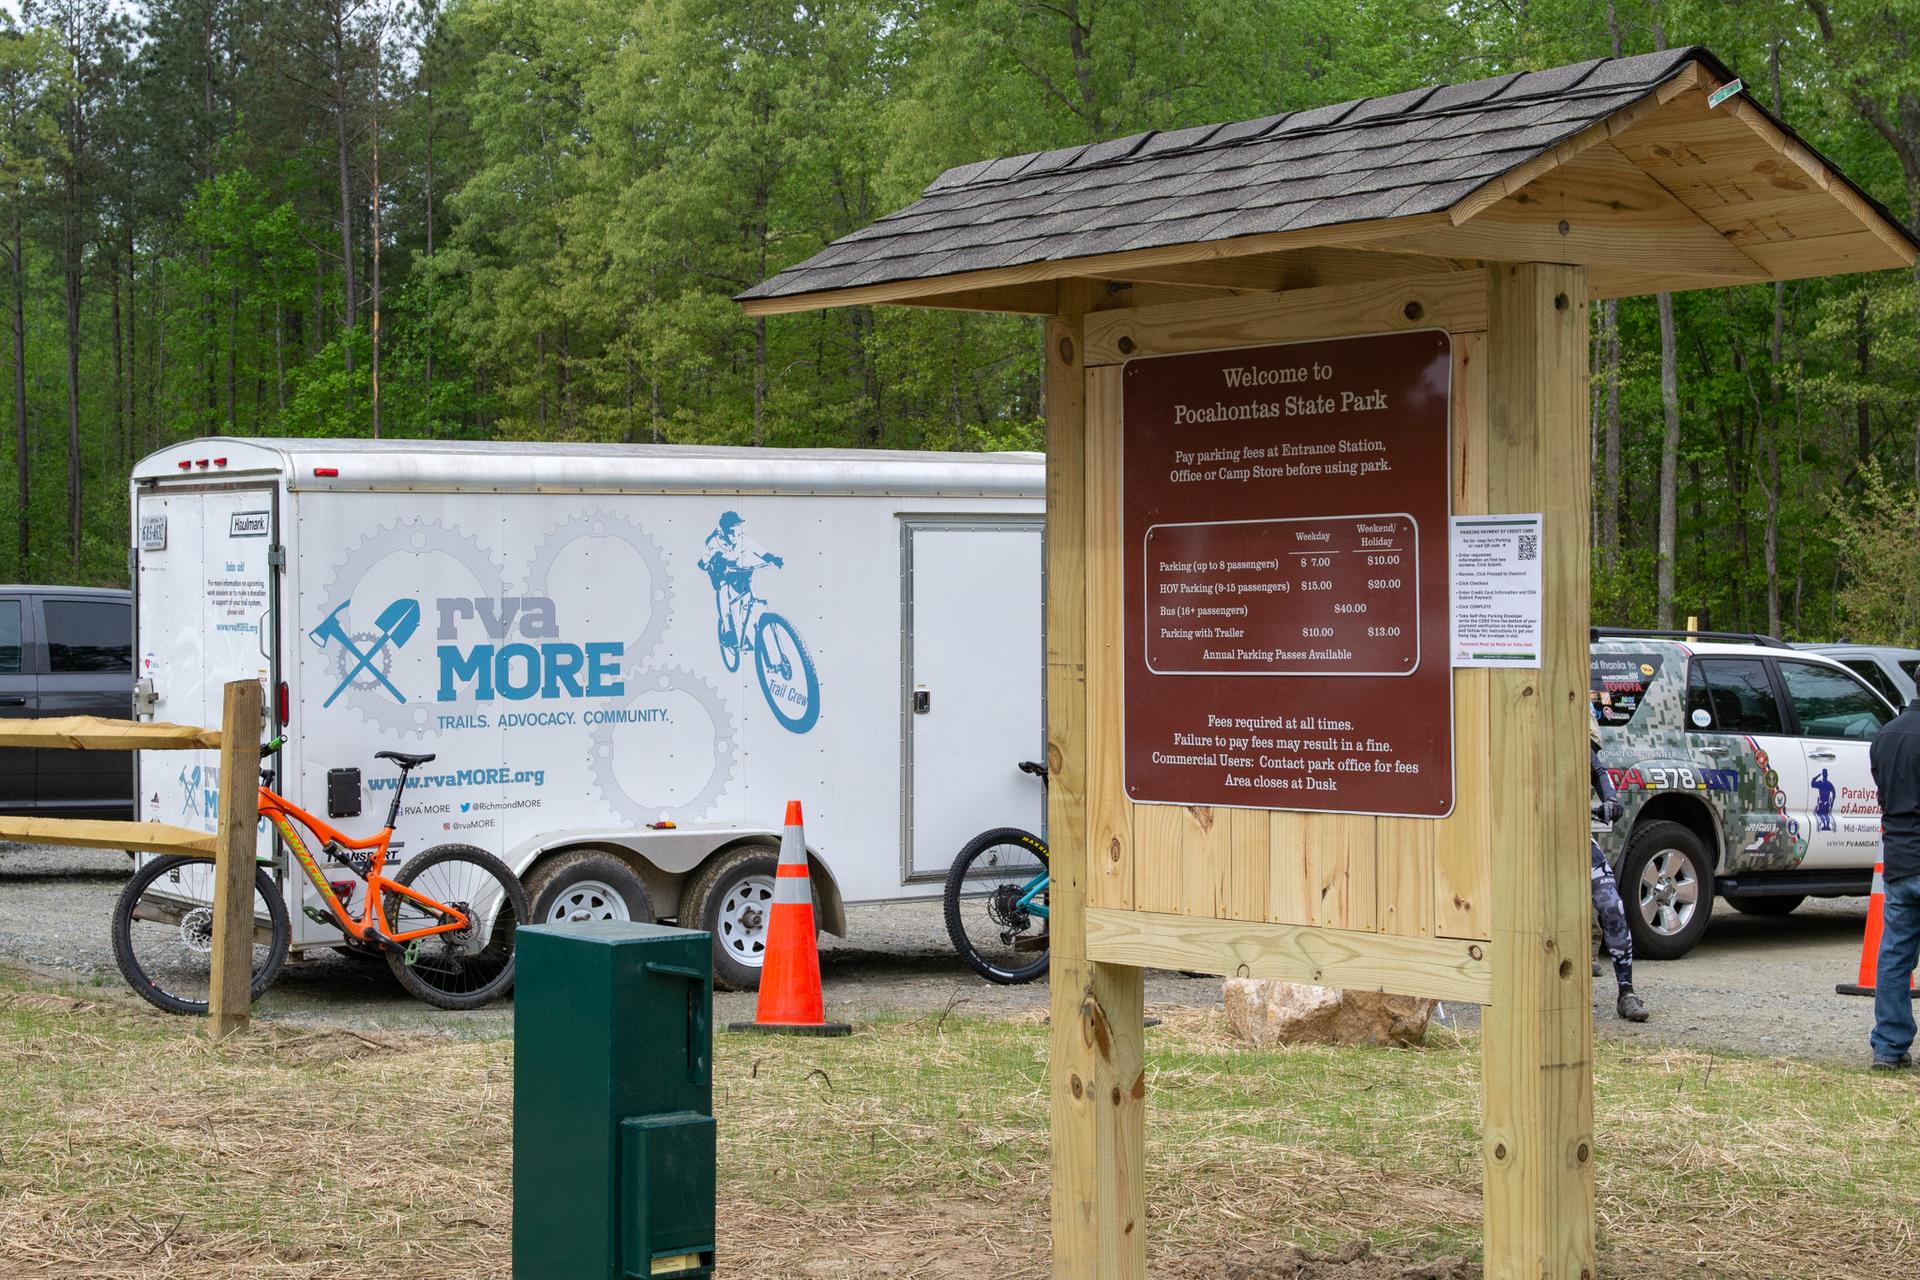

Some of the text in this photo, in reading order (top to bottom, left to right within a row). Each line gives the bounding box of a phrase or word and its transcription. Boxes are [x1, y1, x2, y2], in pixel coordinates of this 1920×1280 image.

[1222, 361, 1332, 388] Welcome to
[1174, 389, 1388, 424] Pocahontas State Park
[1175, 438, 1386, 466] Pay parking fees at Entrance Station,
[1170, 458, 1391, 482] Office or Camp Store before using park.
[234, 518, 265, 531] Haulmark
[1356, 522, 1396, 534] Weekend/
[1295, 531, 1330, 542] Weekday
[1361, 537, 1393, 548] Holiday
[1159, 558, 1278, 573] Parking (up to 8 passengers)
[1300, 557, 1330, 568] $ 7.00
[1367, 555, 1400, 566] $10.00
[1160, 581, 1290, 595] HOV Parking (9-15 passengers)
[1301, 580, 1332, 591] $15.00
[1368, 578, 1400, 590] $20.00
[1160, 604, 1248, 618] Bus (16+ passengers)
[1334, 603, 1366, 614] $40.00
[437, 597, 559, 640] rva
[1160, 627, 1244, 640] Parking with Trailer
[1302, 627, 1333, 637] $10.00
[1367, 626, 1400, 637] $13.00
[1202, 648, 1352, 662] Annual Parking Passes Available
[1600, 660, 1627, 669] thanks
[1628, 661, 1636, 669] to
[437, 642, 624, 702] MORE
[768, 679, 808, 707] Trail Crew
[1605, 682, 1643, 692] TOYOTA
[437, 708, 668, 729] TRAILS. ADVOCACY. COMMUNITY.
[1208, 714, 1354, 731] Fees required at all times.
[1174, 732, 1392, 752] Failure to pay fees may result in a fine.
[1152, 751, 1418, 773] Commercial Users: Contact park office for fees
[368, 768, 544, 790] www.rvaMORE.org
[1224, 773, 1337, 790] Area closes at Dusk
[404, 804, 450, 815] RVA MORE
[472, 800, 542, 811] @RichmondMORE
[1841, 803, 1851, 814] of
[452, 819, 495, 830] @rvaMORE
